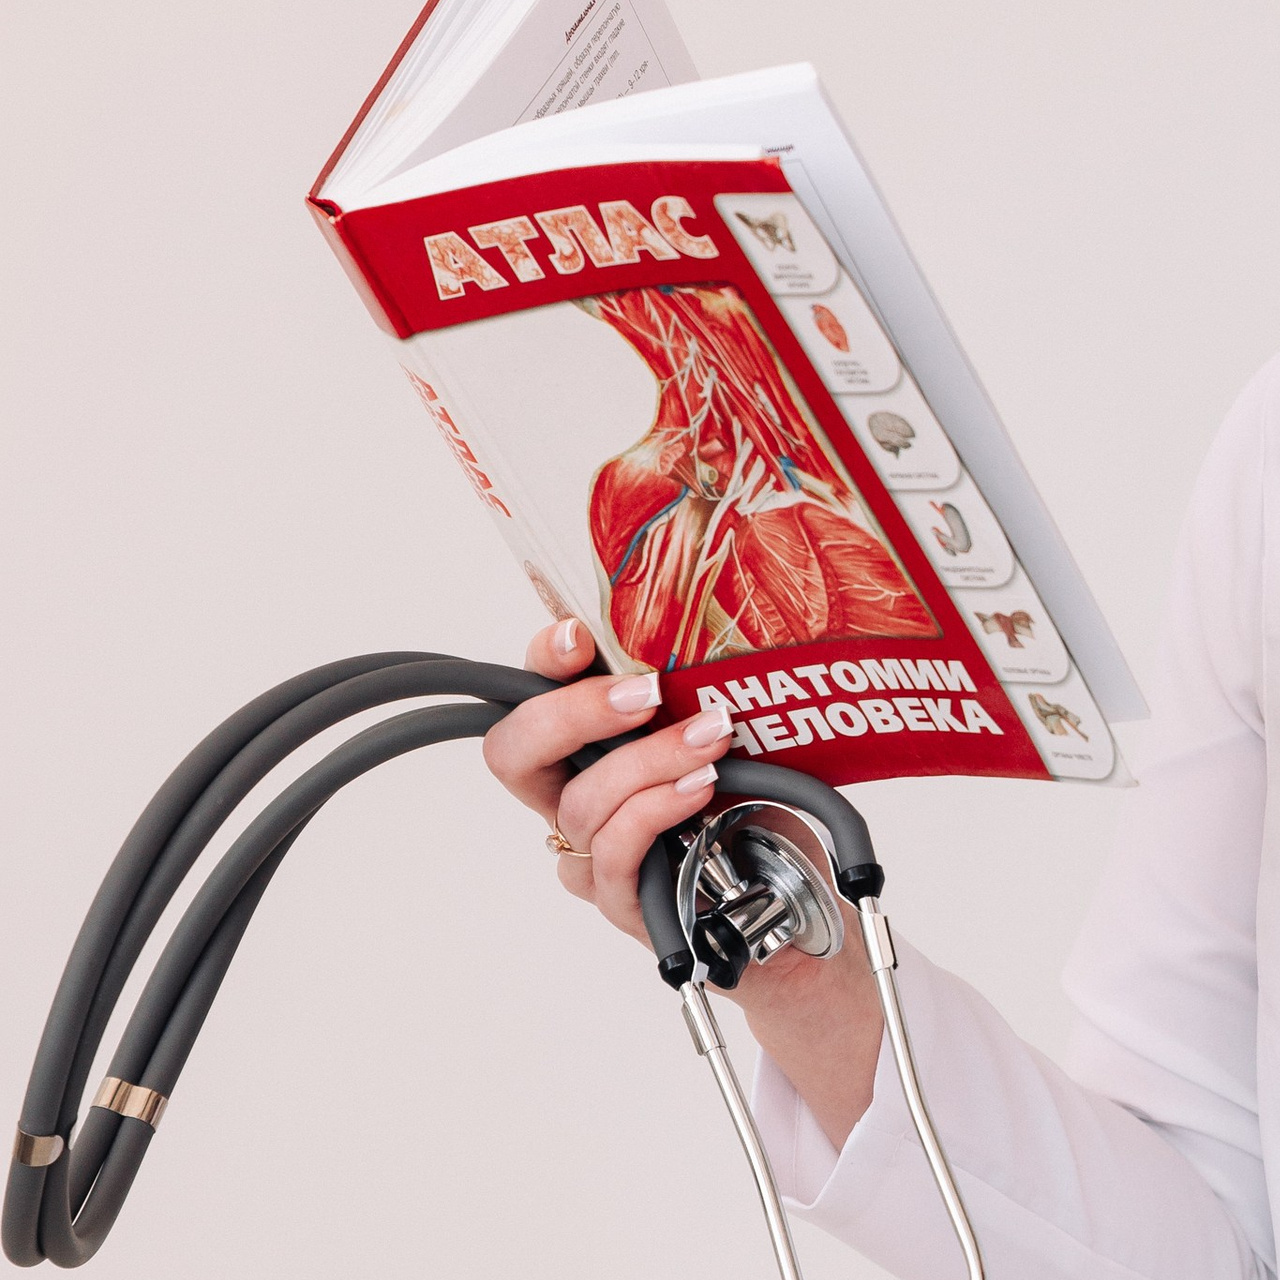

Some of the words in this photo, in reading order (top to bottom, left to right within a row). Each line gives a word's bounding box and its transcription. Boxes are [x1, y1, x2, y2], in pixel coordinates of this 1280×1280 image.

[424, 195, 720, 301] АТЛАС
[412, 372, 512, 517] АТЛАС
[696, 658, 978, 716] АНАТОМИИ
[730, 697, 1004, 756] ЧЕЛОВЕКА
